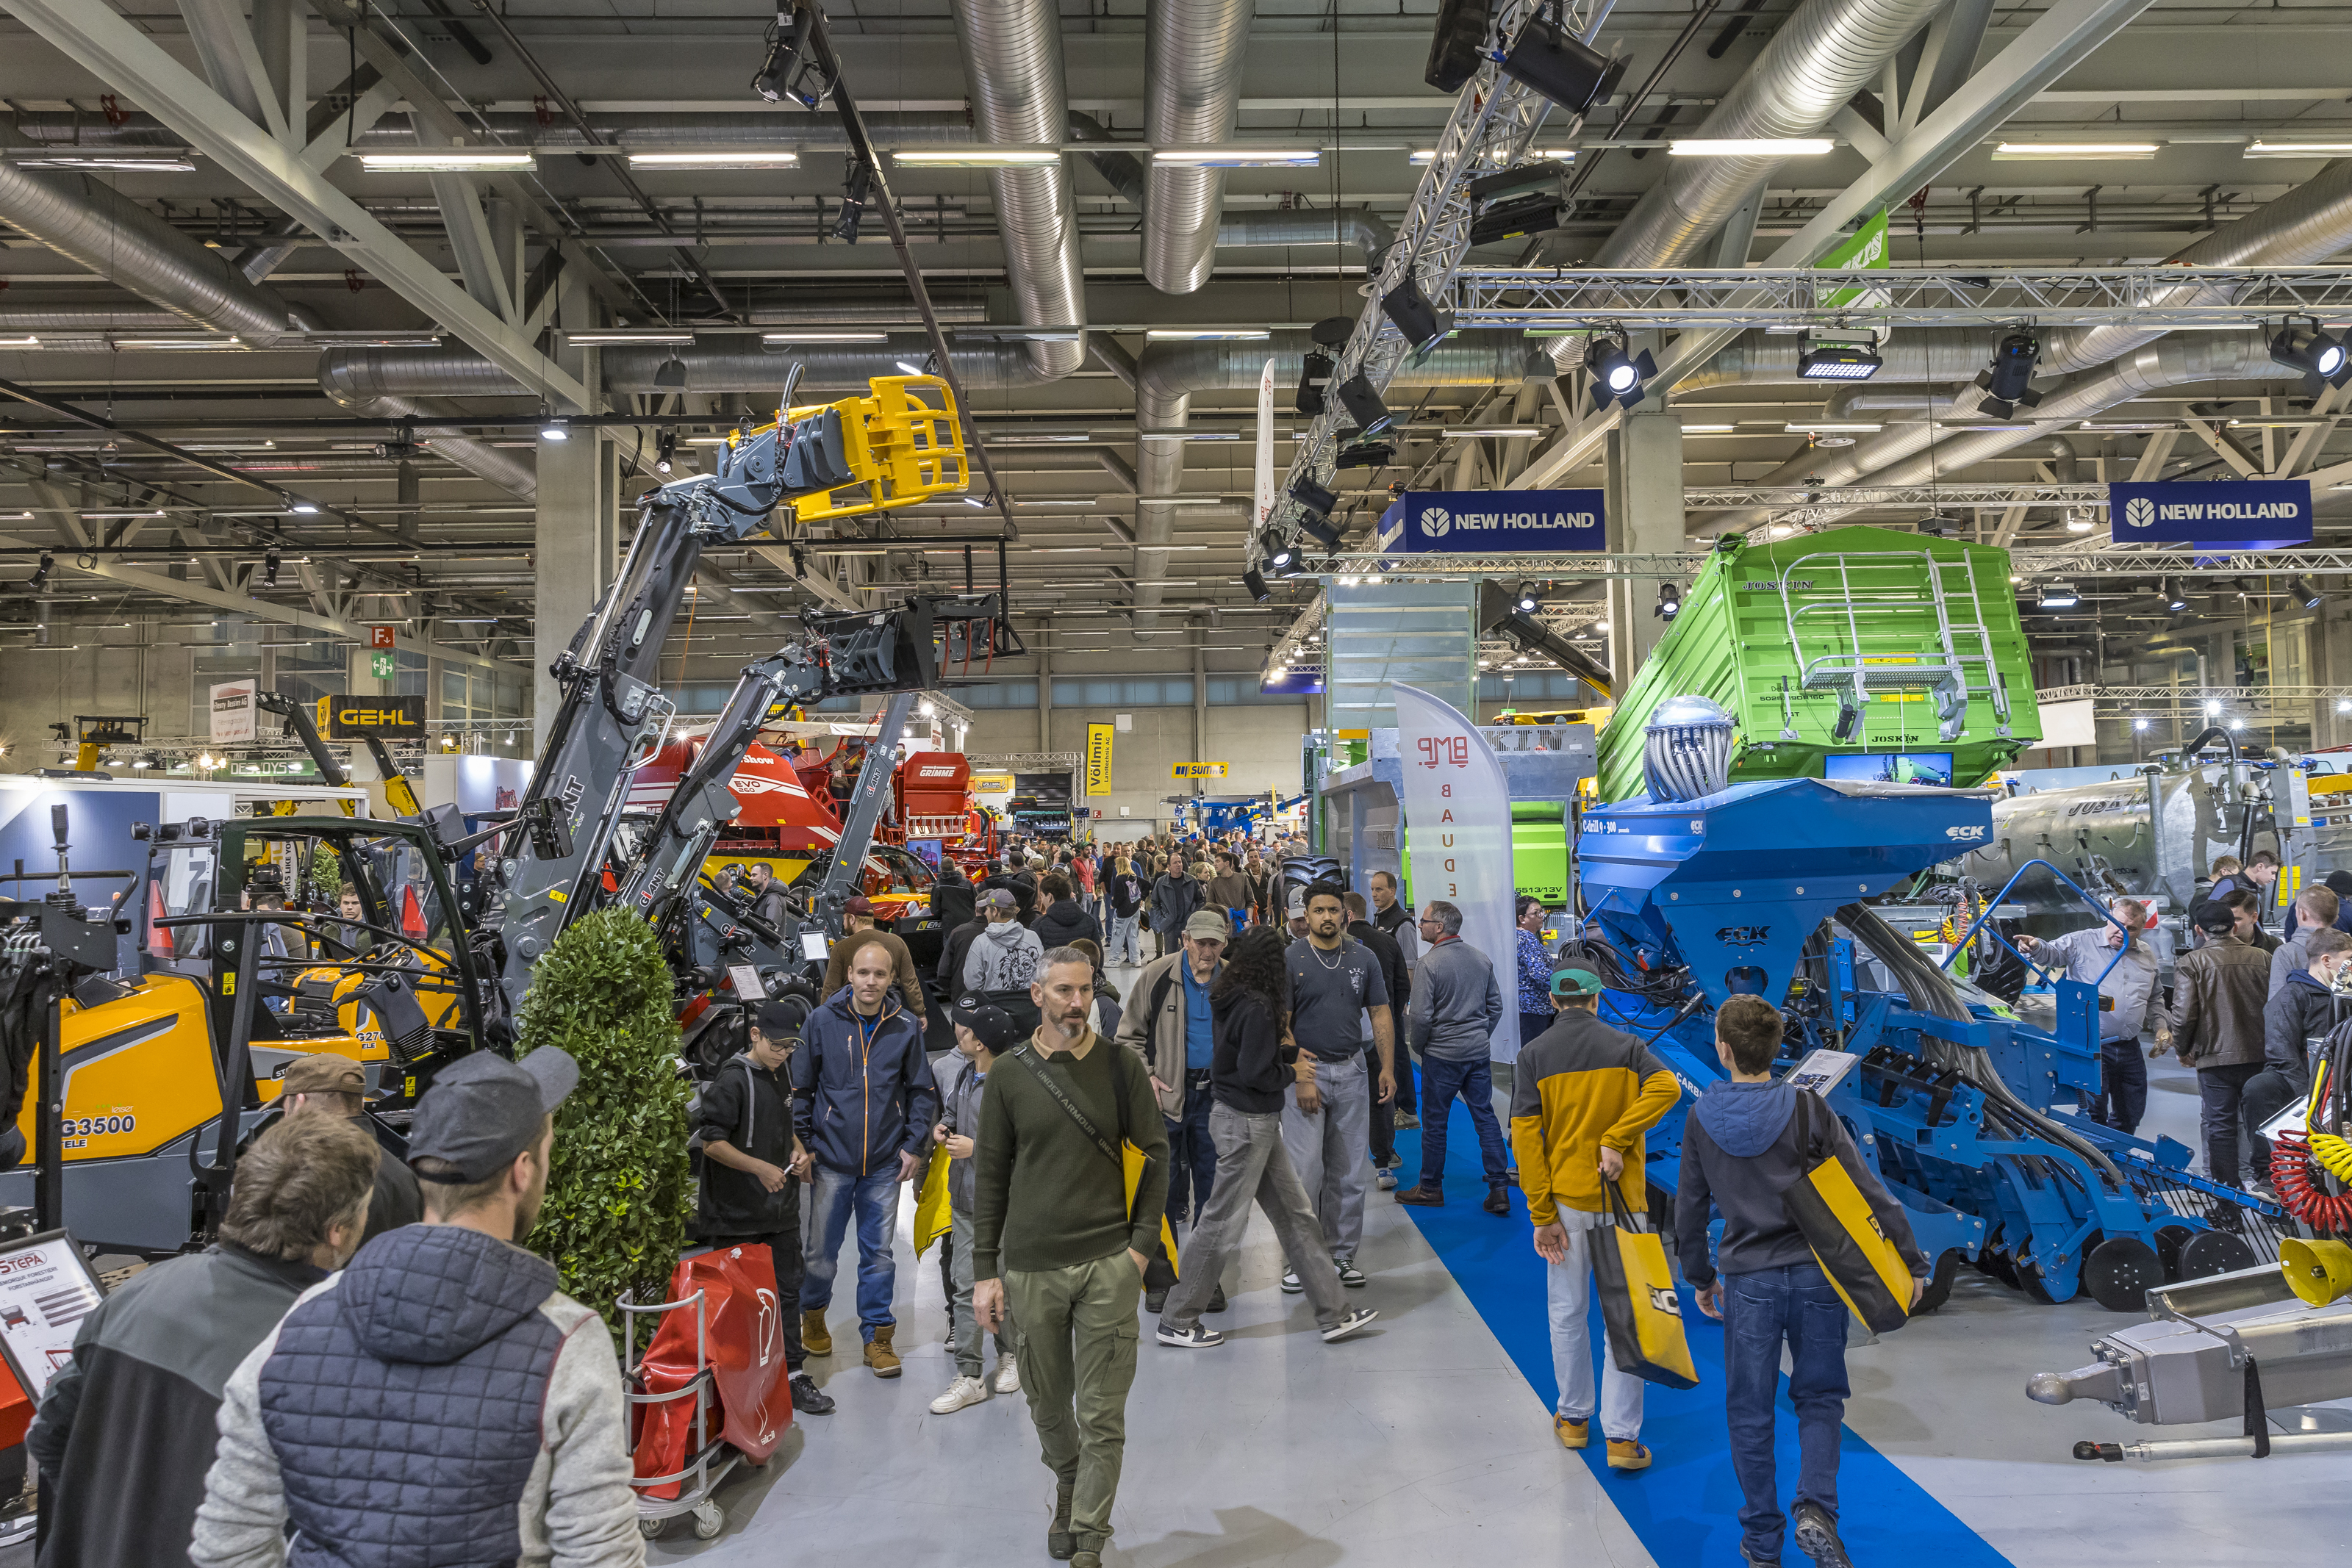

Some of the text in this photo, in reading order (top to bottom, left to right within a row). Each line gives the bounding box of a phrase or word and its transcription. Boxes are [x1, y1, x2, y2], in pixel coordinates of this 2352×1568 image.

[2159, 503, 2298, 520] NEW HOLLAND
[1455, 512, 1595, 530] NEW HOLLAND
[375, 628, 384, 644] F
[339, 709, 415, 725] GEHL
[1105, 737, 1111, 746] AG
[740, 755, 775, 765] Show
[1090, 733, 1102, 787] Völlmin
[231, 762, 287, 774] DESOYS
[1191, 765, 1225, 774] SUMAG
[401, 789, 410, 805] GEHL
[1607, 821, 1616, 835] 300
[1690, 820, 1703, 831] ECK
[1946, 825, 1985, 837] ECK
[1715, 926, 1772, 941] ECK
[111, 1104, 134, 1113] leiser
[1037, 1070, 1063, 1098] UNDER
[1061, 1098, 1096, 1136] ARMOUR
[1098, 1138, 1121, 1164] UNDER
[62, 1115, 136, 1138] G3500
